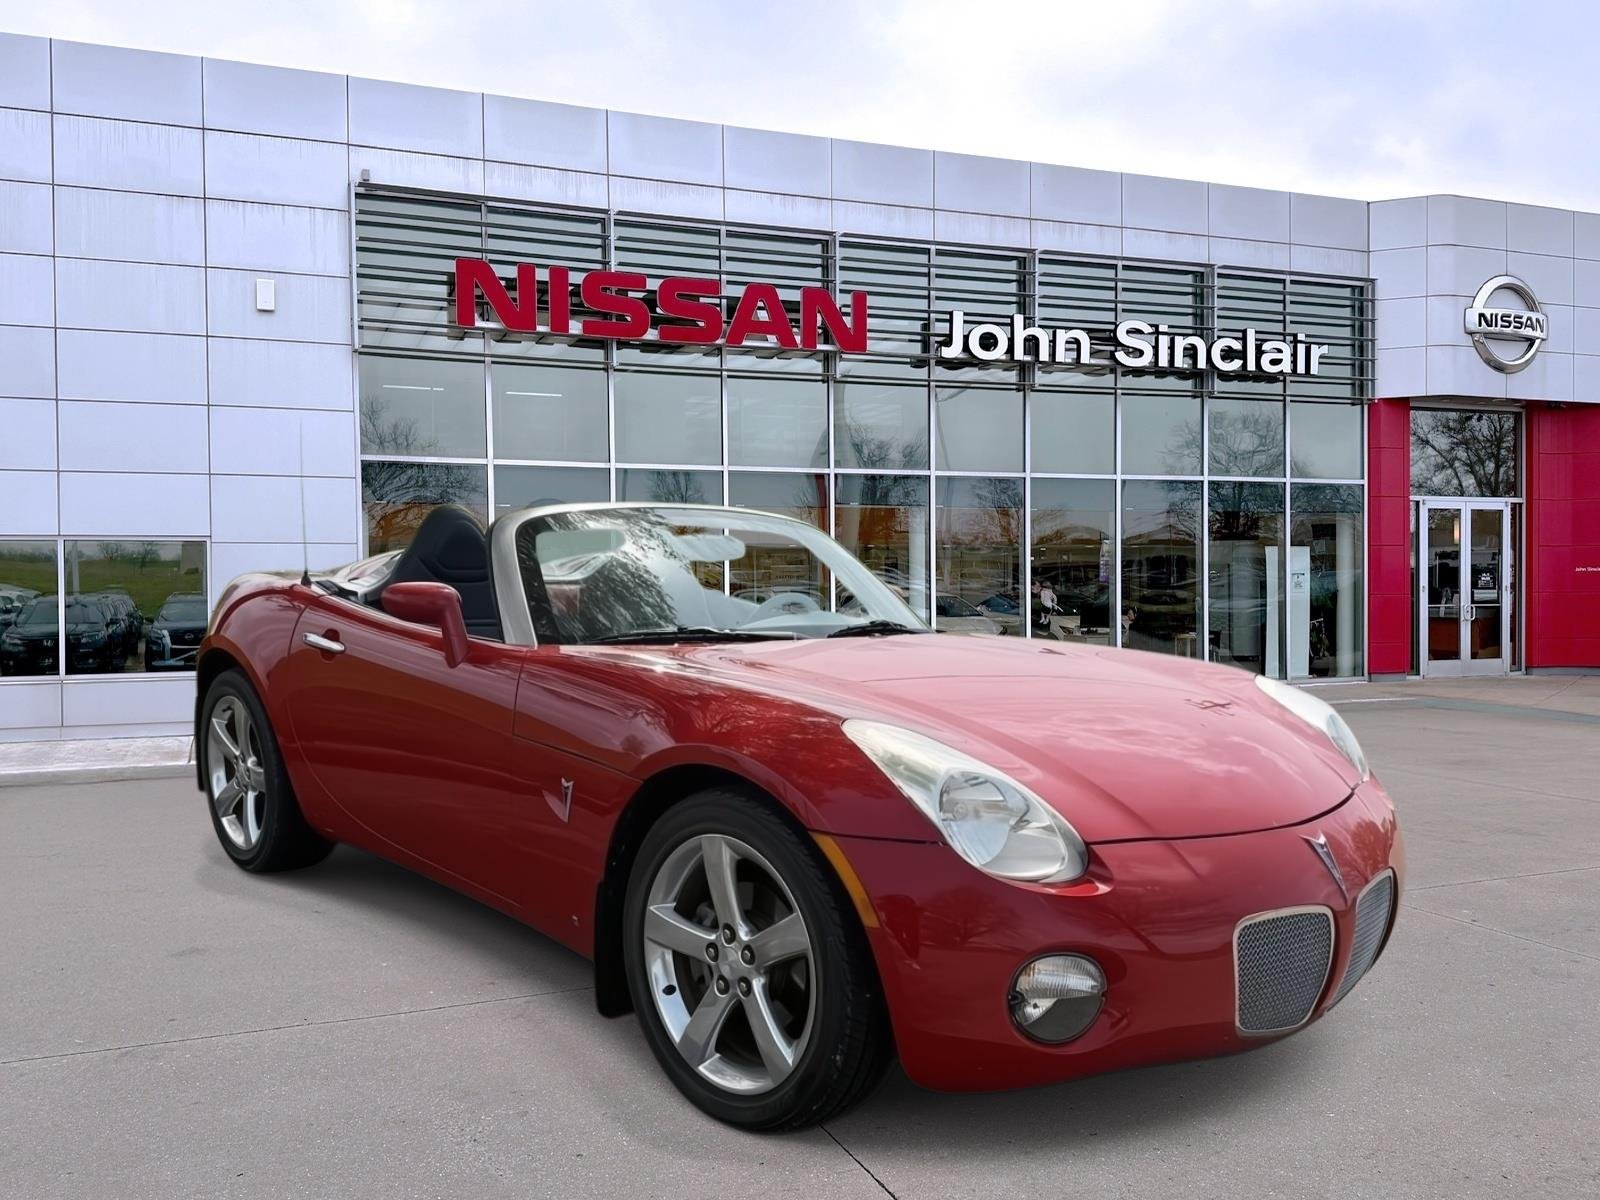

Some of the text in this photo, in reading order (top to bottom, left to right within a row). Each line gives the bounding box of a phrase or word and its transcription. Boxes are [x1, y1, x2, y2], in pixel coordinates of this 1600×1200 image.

[454, 258, 868, 353] NISSAN
[1477, 312, 1544, 333] NISSAN
[940, 309, 1329, 375] John Sinclair
